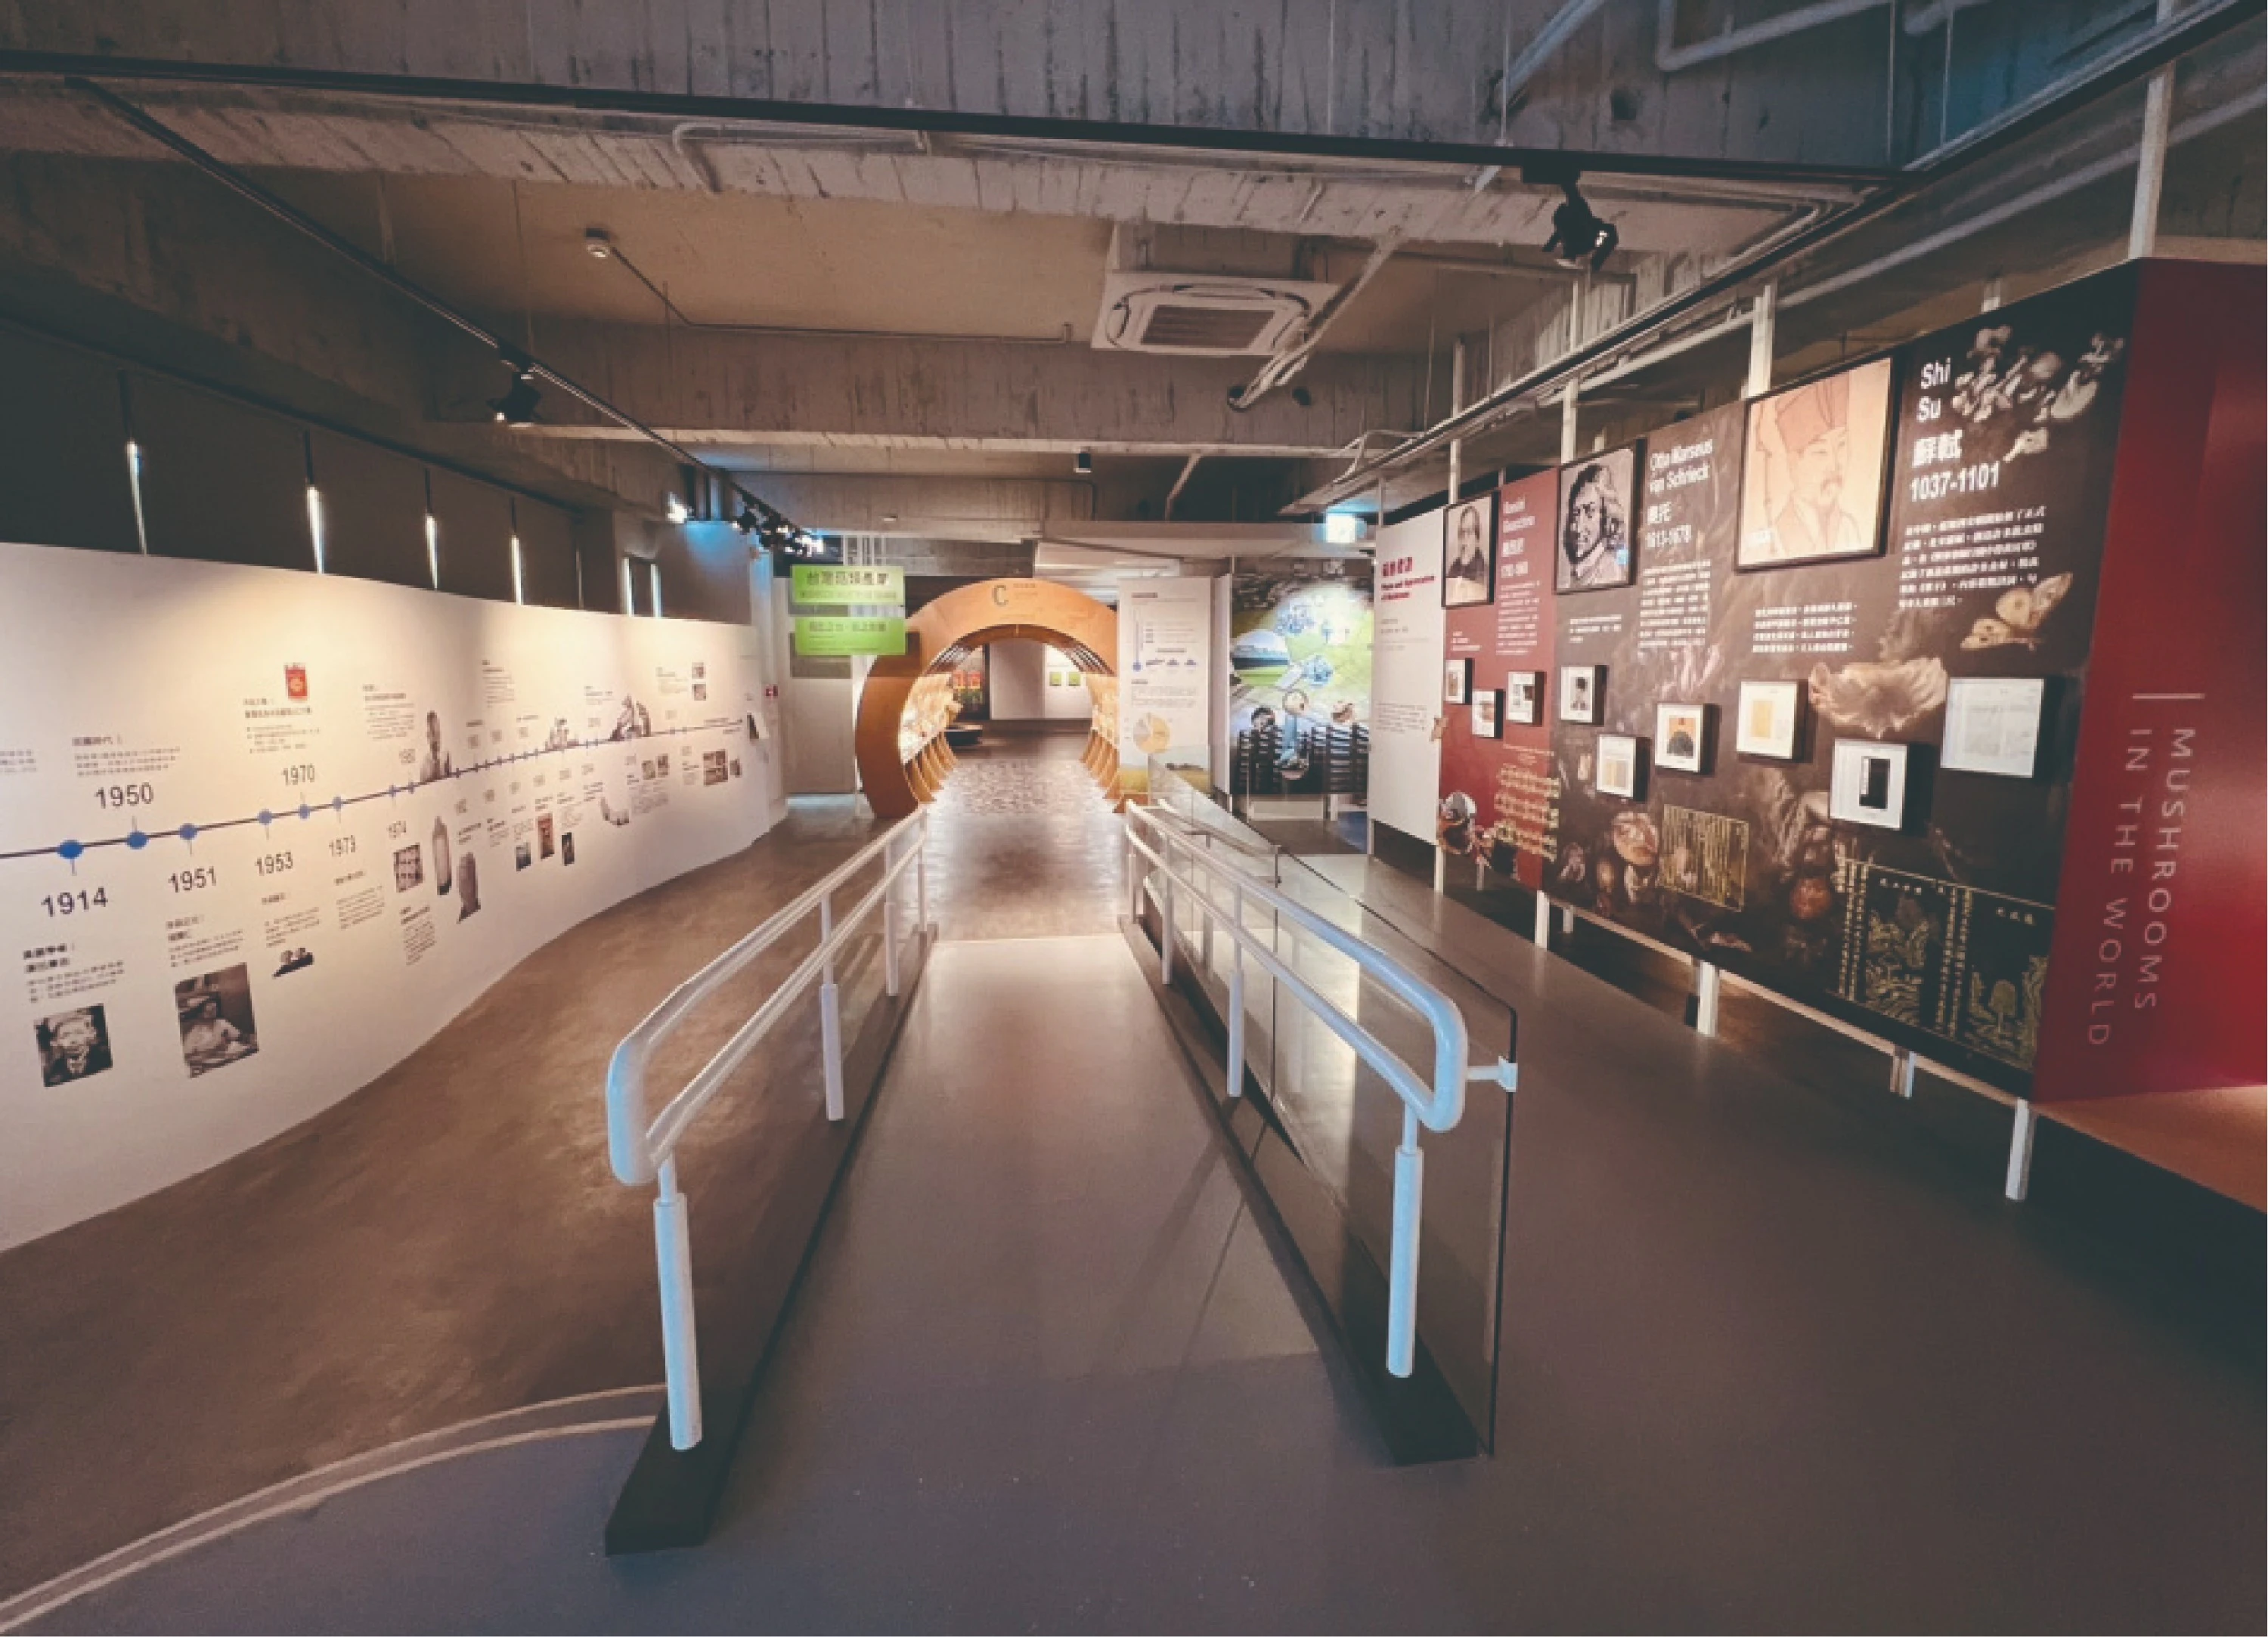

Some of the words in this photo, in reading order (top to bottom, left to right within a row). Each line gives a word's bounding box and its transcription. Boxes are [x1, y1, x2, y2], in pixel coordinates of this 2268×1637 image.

[1920, 357, 1950, 389] Shi
[1916, 395, 1941, 422] Su
[1910, 461, 2000, 502] 1037-1101
[992, 584, 1009, 605] C
[2125, 729, 2153, 772] IN
[281, 763, 315, 786] 1970
[94, 781, 154, 816] 1950
[2111, 797, 2143, 874] THE
[168, 865, 217, 893] 1951
[255, 851, 294, 876] 1953
[2134, 728, 2195, 1010] MUSHROOMS
[41, 886, 109, 918] 1914
[2088, 897, 2129, 1045] WORLD
